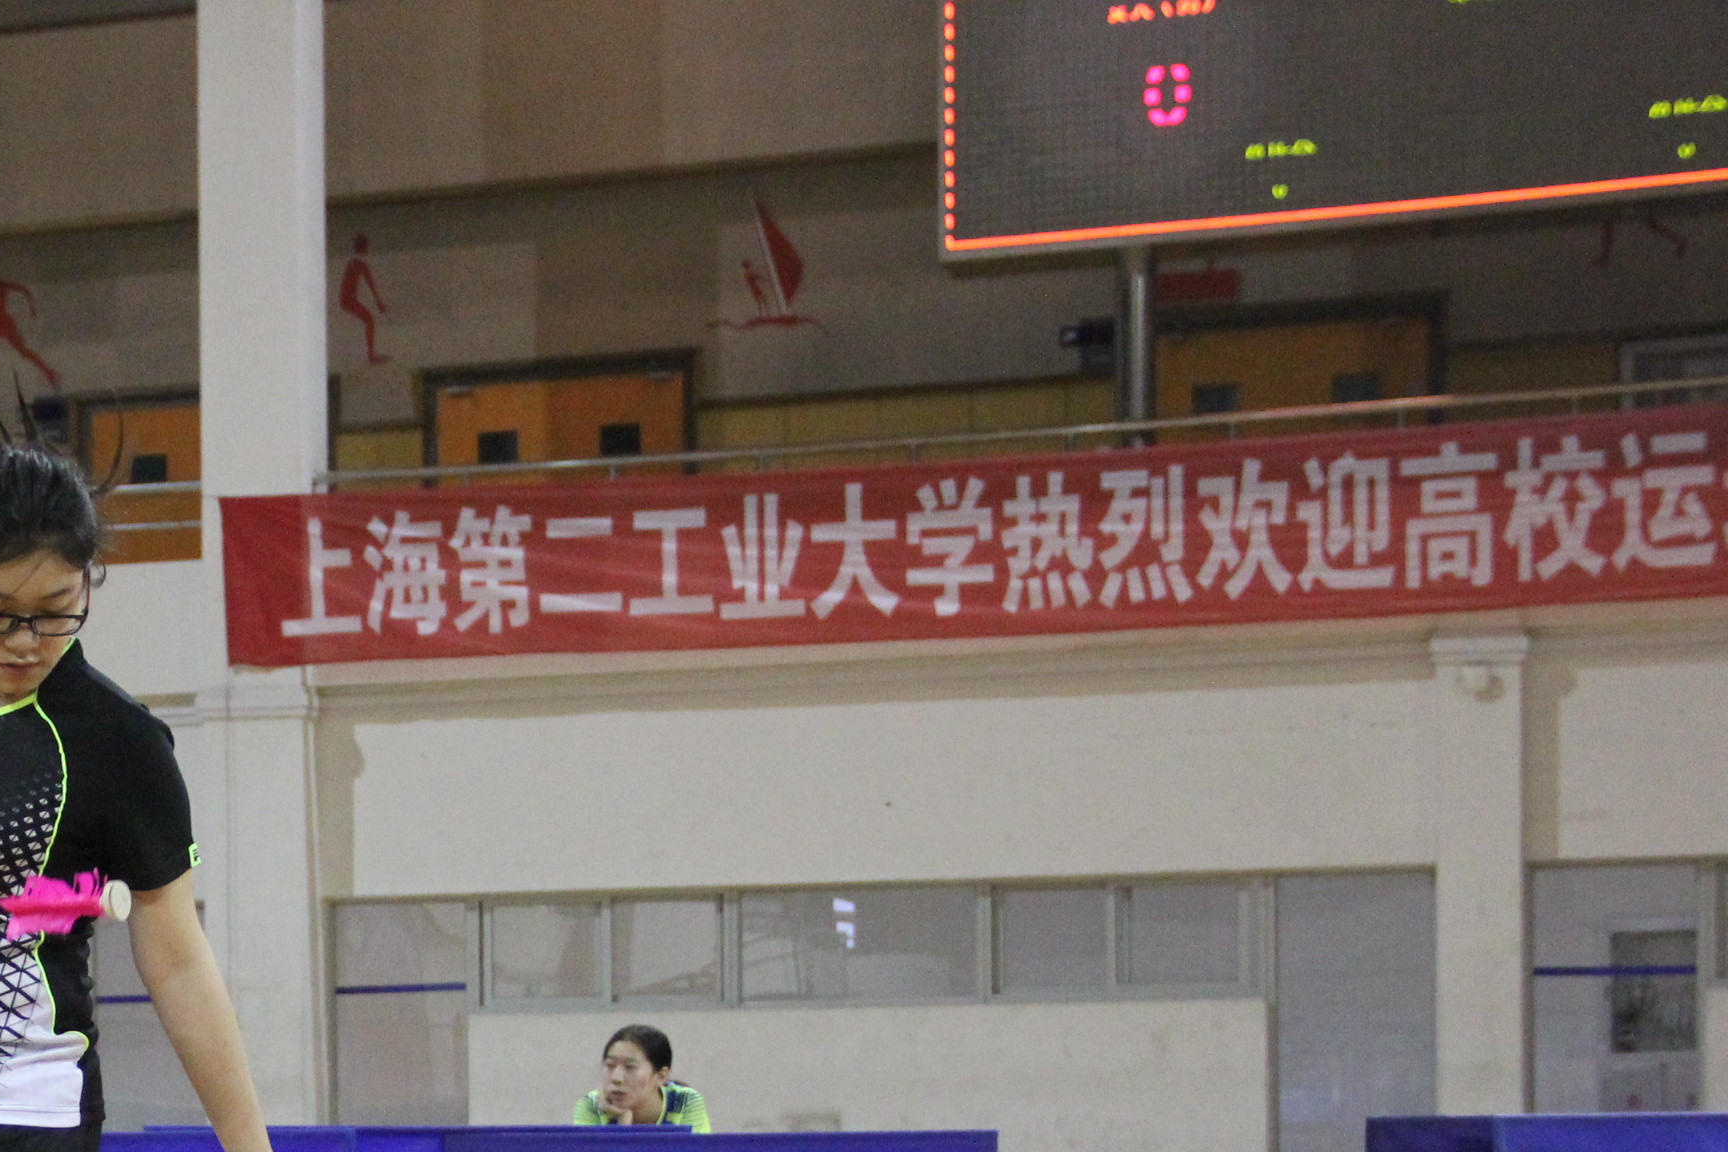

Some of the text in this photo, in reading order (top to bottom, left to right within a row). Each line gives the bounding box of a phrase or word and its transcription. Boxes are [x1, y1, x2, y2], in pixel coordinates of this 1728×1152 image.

[280, 431, 1728, 638] 上海第二工业大学热烈欢迎高校运
